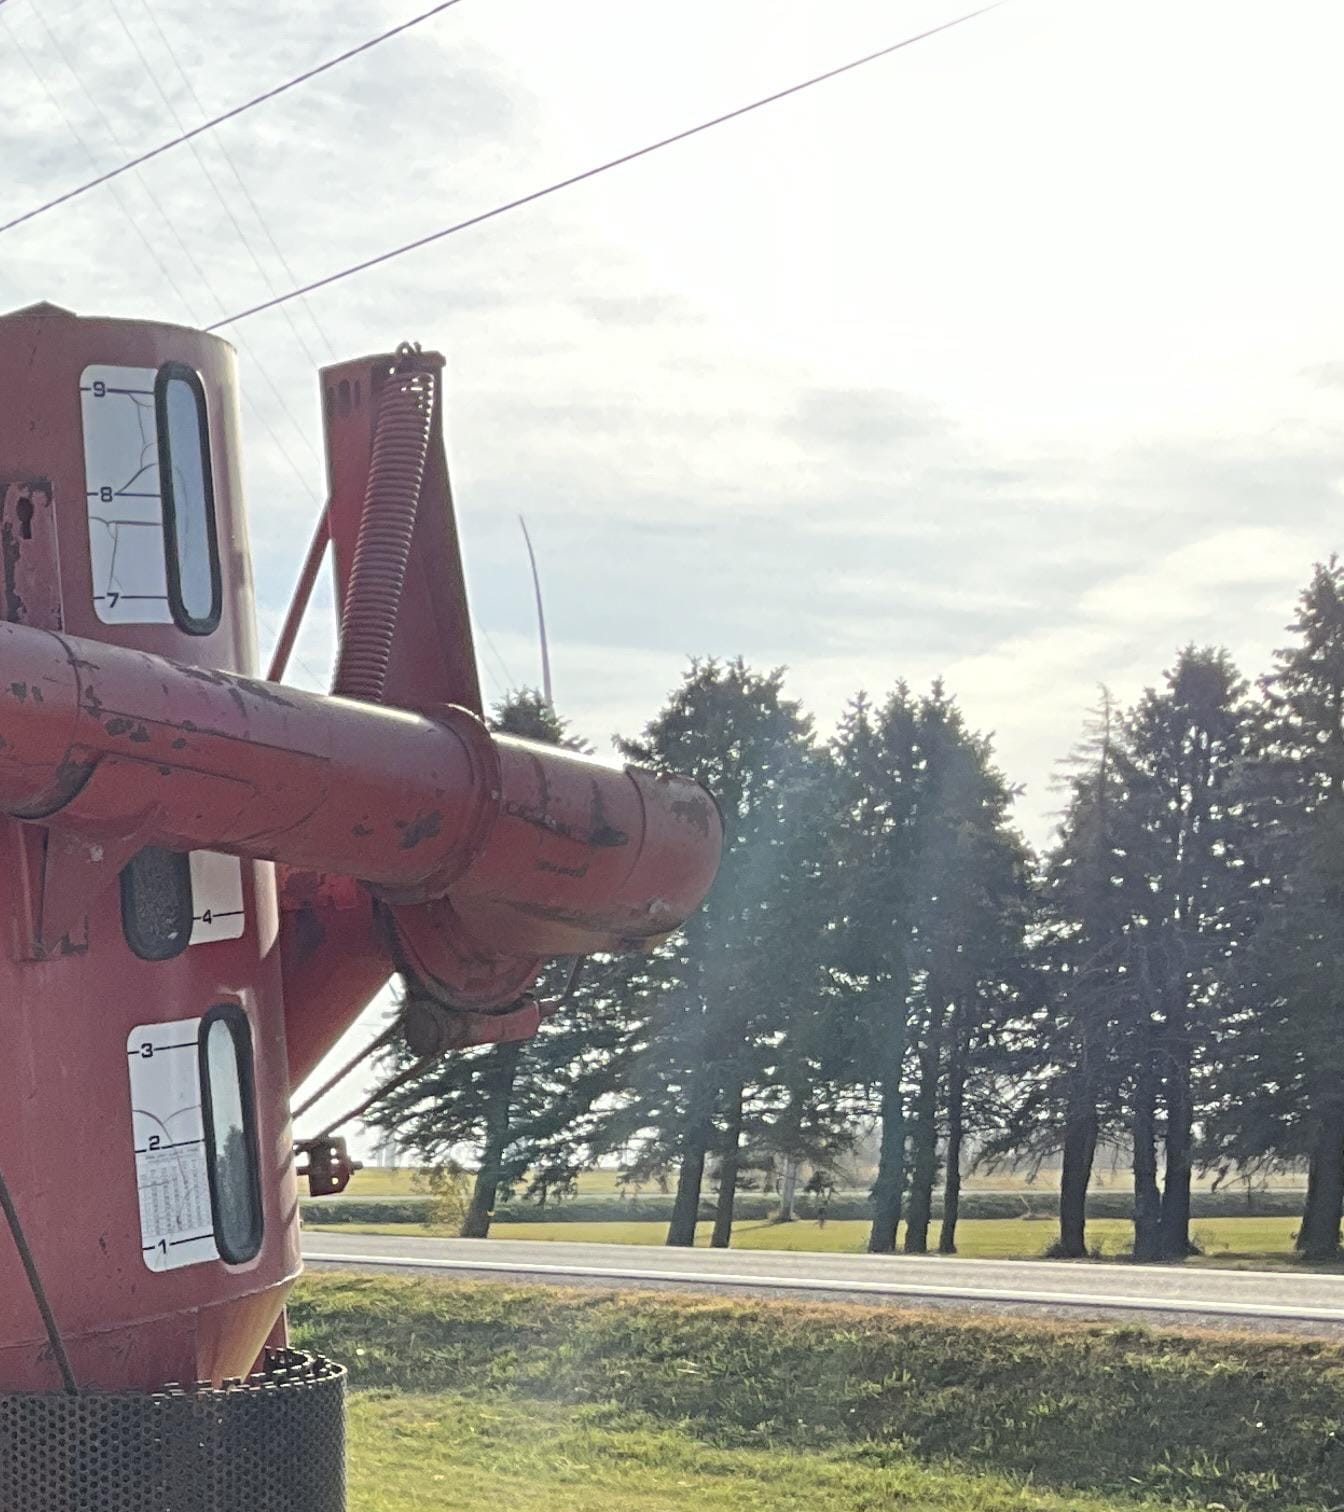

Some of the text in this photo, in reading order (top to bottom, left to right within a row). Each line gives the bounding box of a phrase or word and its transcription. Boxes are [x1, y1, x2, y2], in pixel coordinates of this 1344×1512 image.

[93, 381, 105, 397] 9
[100, 486, 113, 502] 8
[106, 592, 119, 608] 7
[201, 909, 213, 924] 4
[140, 1042, 154, 1058] 3
[148, 1135, 161, 1151] 2
[157, 1239, 167, 1254] 1
